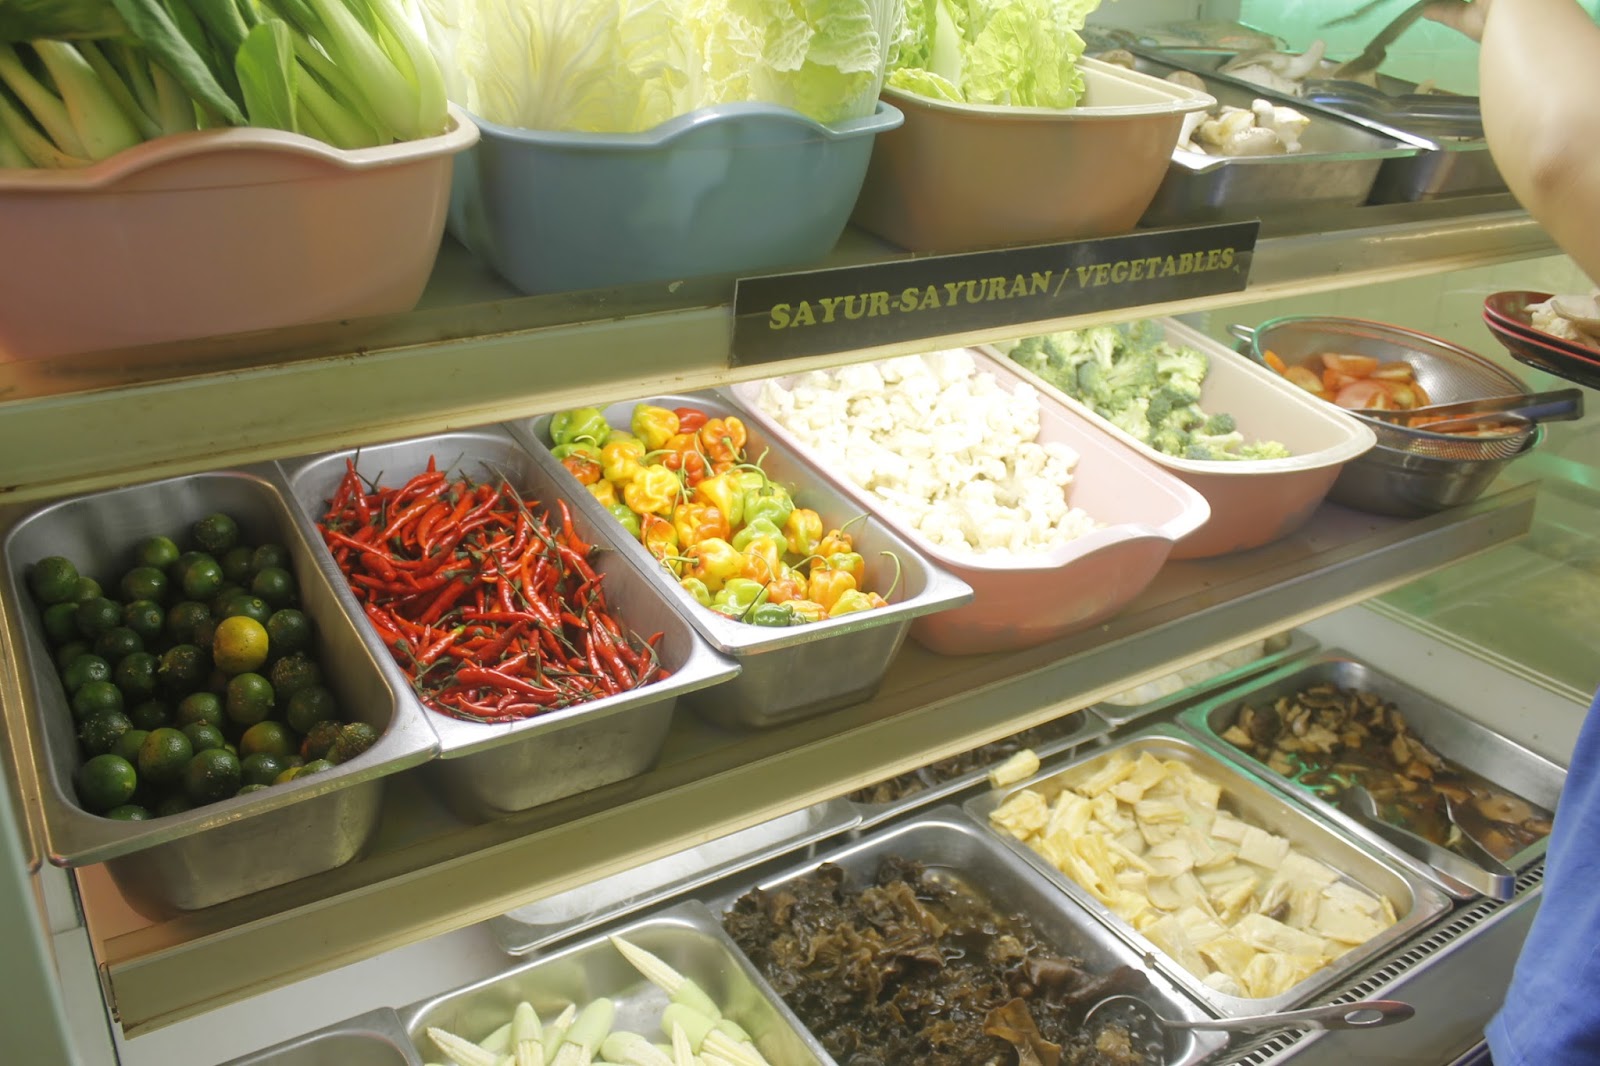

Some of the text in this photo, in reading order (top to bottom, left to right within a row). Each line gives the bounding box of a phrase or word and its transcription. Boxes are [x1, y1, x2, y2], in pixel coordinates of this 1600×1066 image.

[769, 248, 1235, 330] SAYUR-SAYURAN / VEGETABLES
